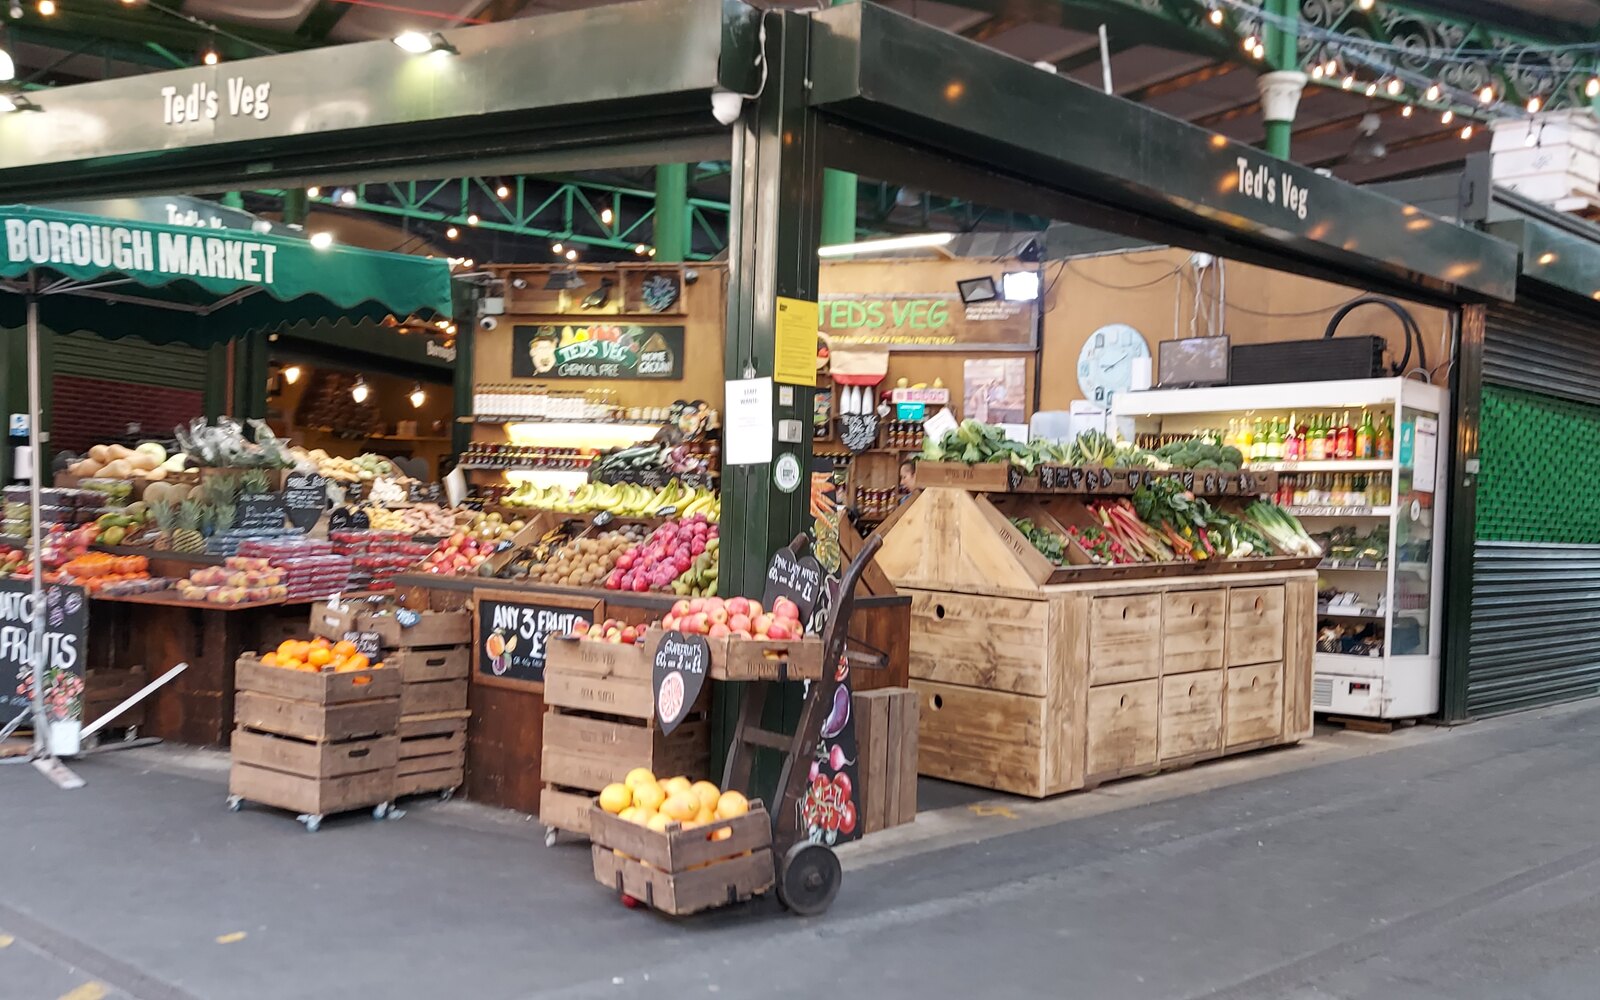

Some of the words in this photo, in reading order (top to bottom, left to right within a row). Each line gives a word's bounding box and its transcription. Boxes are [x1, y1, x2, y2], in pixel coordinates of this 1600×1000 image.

[161, 81, 219, 124] Ted's
[228, 76, 271, 120] Veg
[1237, 156, 1276, 204] Ted's
[1281, 172, 1308, 220] Veg
[5, 219, 154, 272] BOROUGH
[158, 232, 277, 285] MARKET
[892, 300, 949, 329] VEG
[492, 604, 520, 631] ANY
[520, 608, 536, 640] 3
